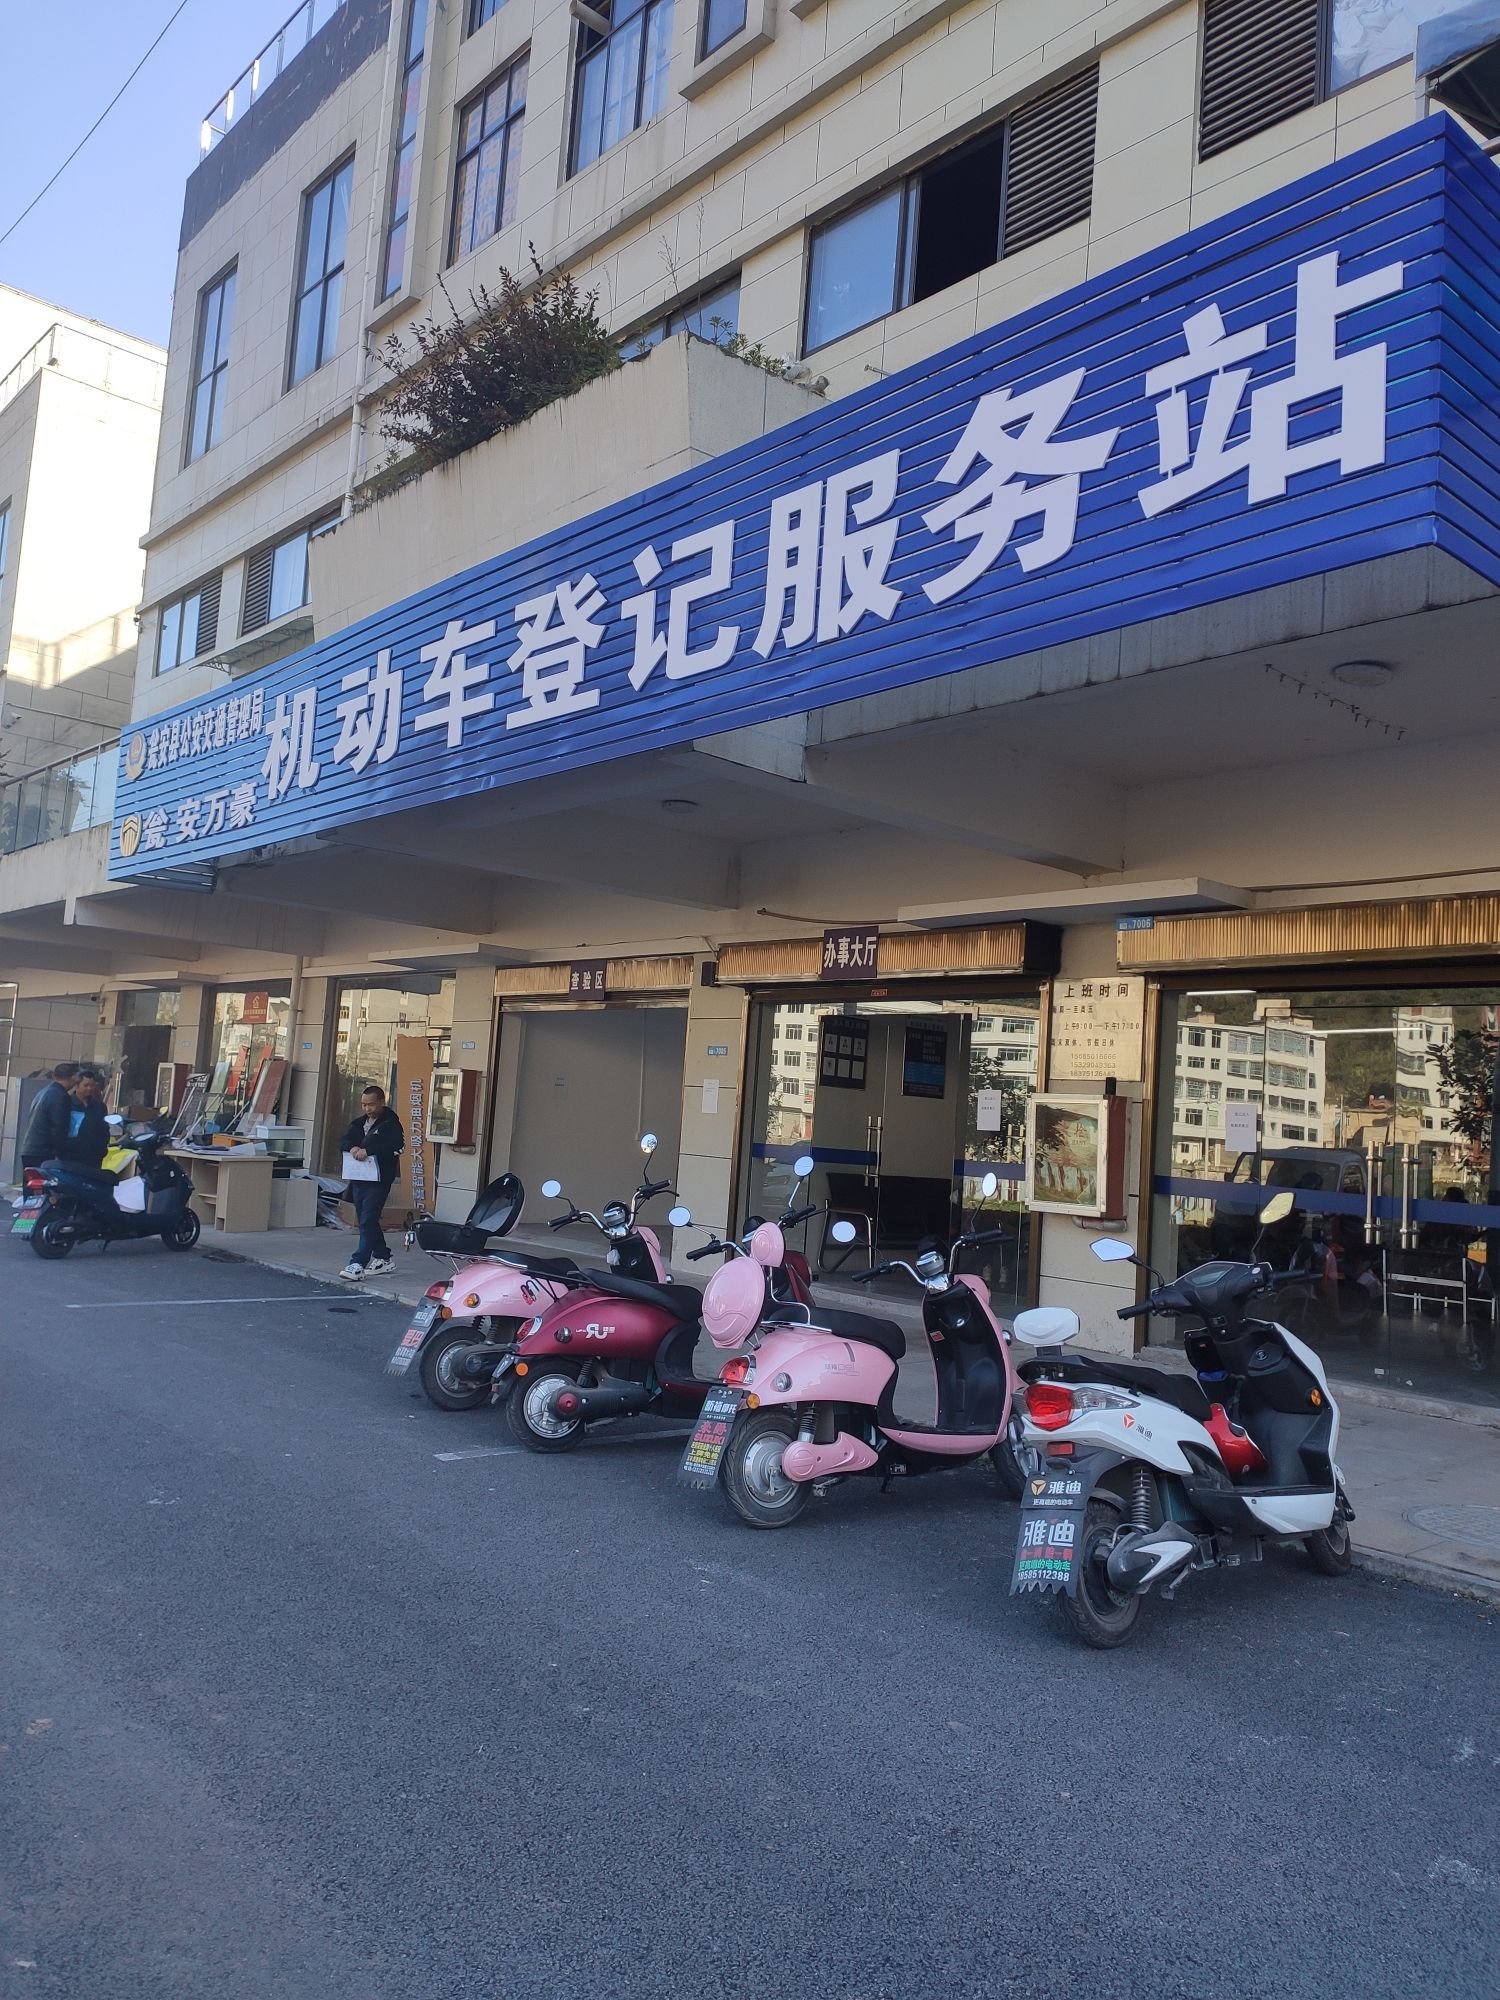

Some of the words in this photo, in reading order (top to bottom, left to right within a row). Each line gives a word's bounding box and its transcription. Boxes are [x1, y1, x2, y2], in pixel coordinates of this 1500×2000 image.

[259, 249, 1404, 800] 机动车登记服务站
[147, 687, 265, 770] 瓮安县公安交通管理局
[1132, 918, 1151, 929] 7006
[823, 935, 877, 968] 办事大厅
[570, 970, 604, 991] 查验区
[1064, 983, 1129, 998] 上班时间
[1047, 1480, 1082, 1495] 雅迪
[1021, 1519, 1075, 1548] 雅迪
